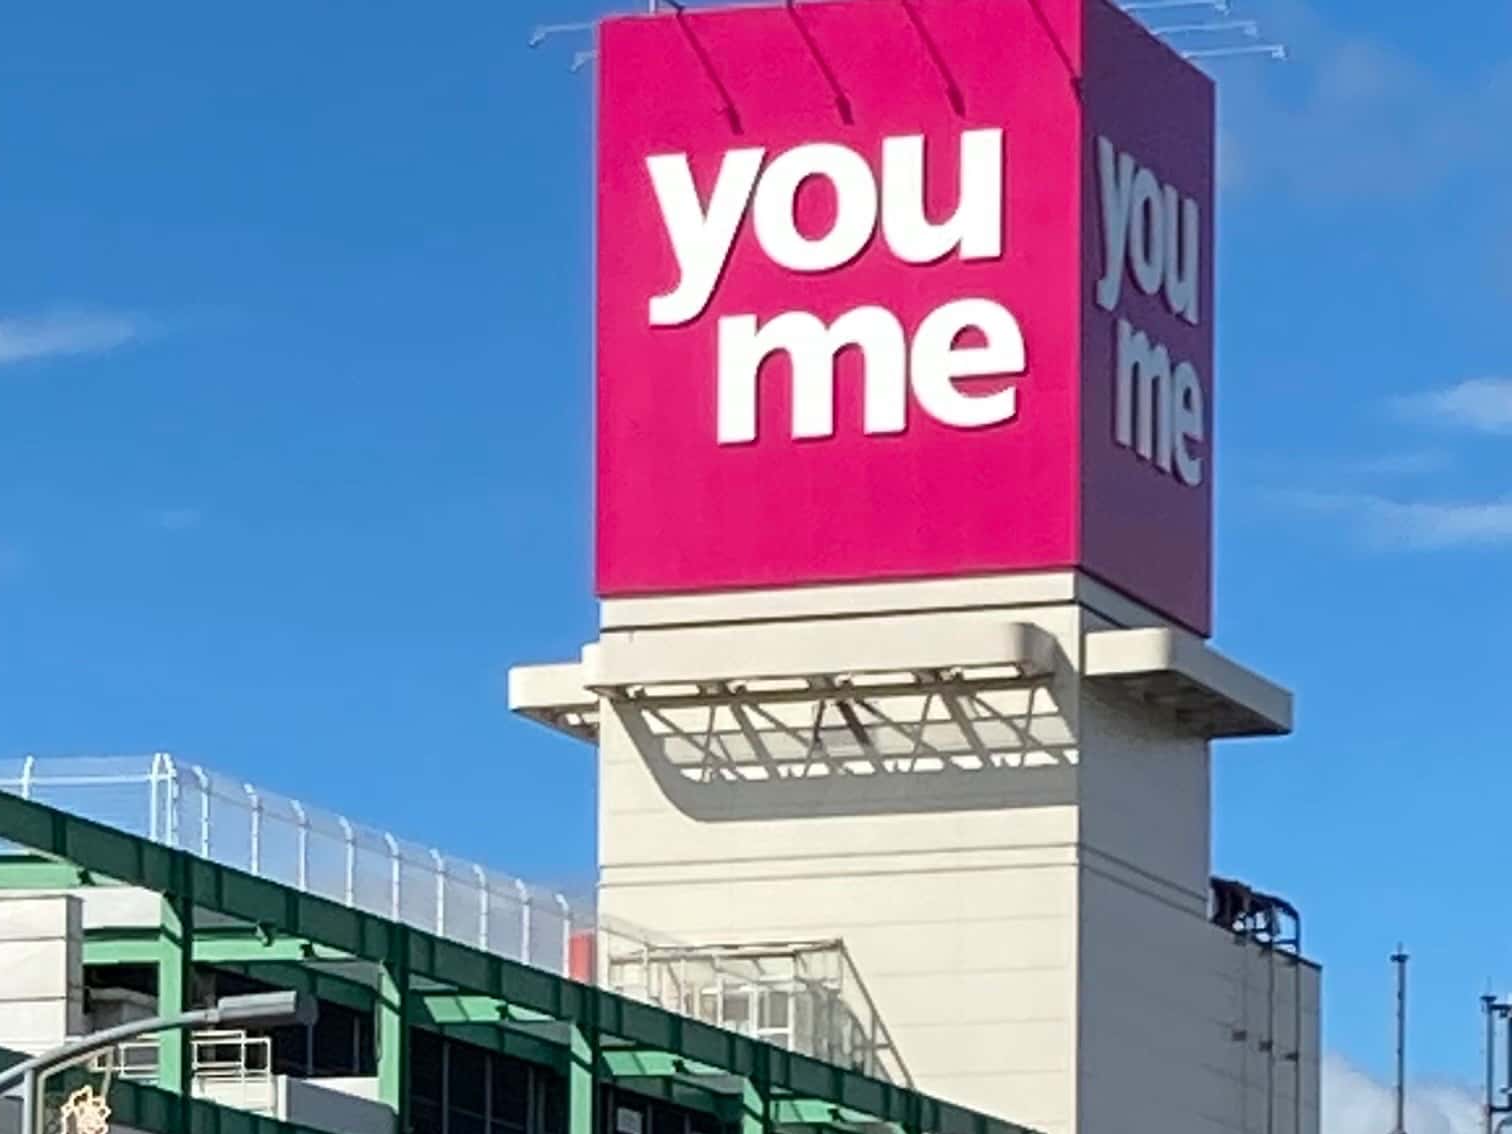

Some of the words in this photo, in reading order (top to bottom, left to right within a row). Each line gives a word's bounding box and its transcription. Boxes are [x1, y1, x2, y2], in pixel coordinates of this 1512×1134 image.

[645, 127, 1005, 327] you
[1095, 135, 1200, 326] you
[716, 296, 1026, 447] me
[1114, 318, 1205, 487] me
